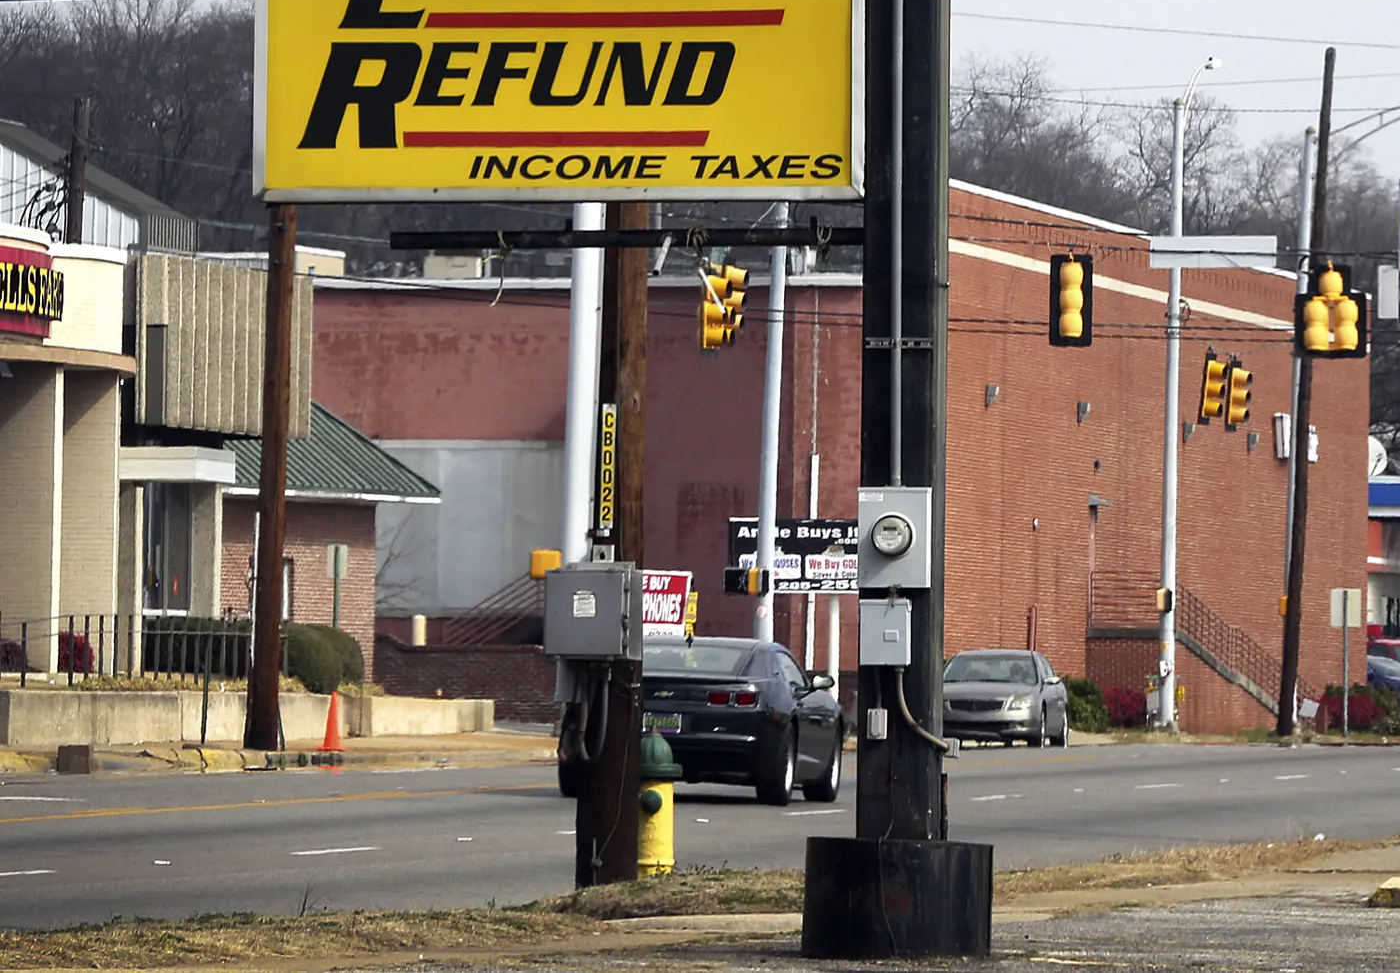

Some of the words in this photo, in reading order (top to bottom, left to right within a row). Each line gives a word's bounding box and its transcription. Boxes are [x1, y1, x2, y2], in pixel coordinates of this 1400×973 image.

[298, 41, 736, 149] REFUND
[468, 154, 666, 180] INCOME
[690, 154, 844, 179] TAXES
[796, 527, 842, 541] Buys
[649, 576, 672, 591] BUY
